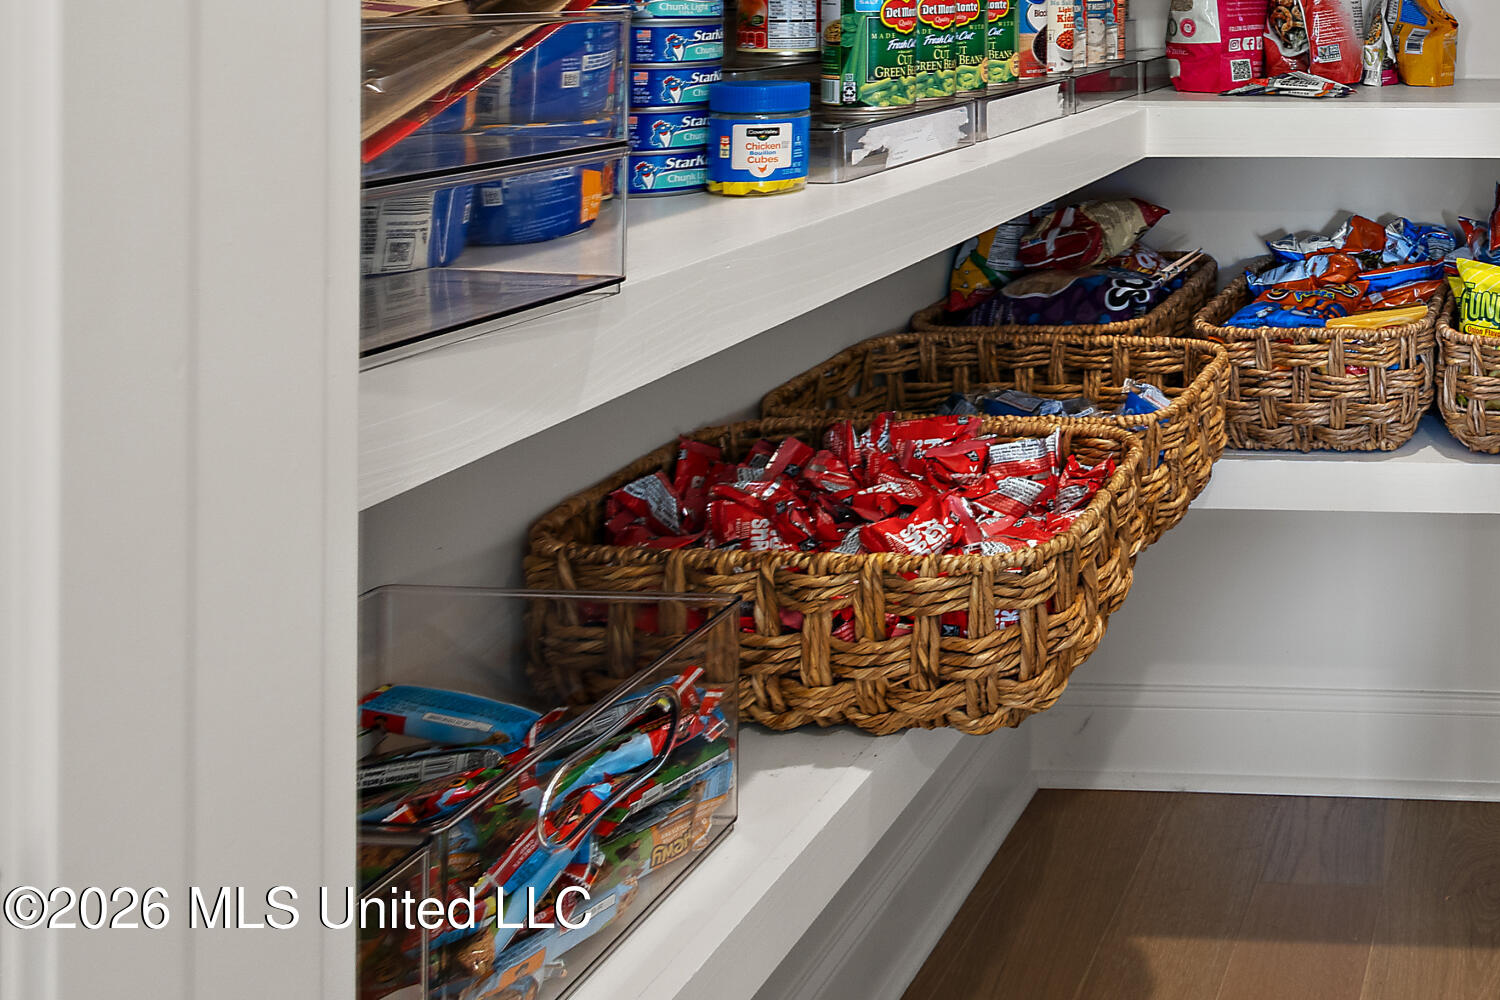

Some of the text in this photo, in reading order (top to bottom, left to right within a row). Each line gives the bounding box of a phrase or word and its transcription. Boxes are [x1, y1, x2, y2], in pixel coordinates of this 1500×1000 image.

[658, 2, 690, 11] Chunk
[922, 4, 936, 15] Del
[957, 3, 977, 12] onte
[988, 1, 1007, 10] onte
[886, 7, 900, 18] Del
[887, 39, 907, 51] Fresh
[924, 34, 943, 46] Fresh
[897, 54, 914, 65] CUT
[934, 48, 950, 60] CUT
[959, 54, 982, 65] BEANS
[989, 49, 1013, 59] BEANS
[875, 66, 906, 78] GREEN
[682, 116, 710, 127] Star
[745, 142, 781, 150] Chicken
[665, 157, 706, 169] StarK
[747, 156, 779, 164] Cubes
[1468, 325, 1483, 336] Onion
